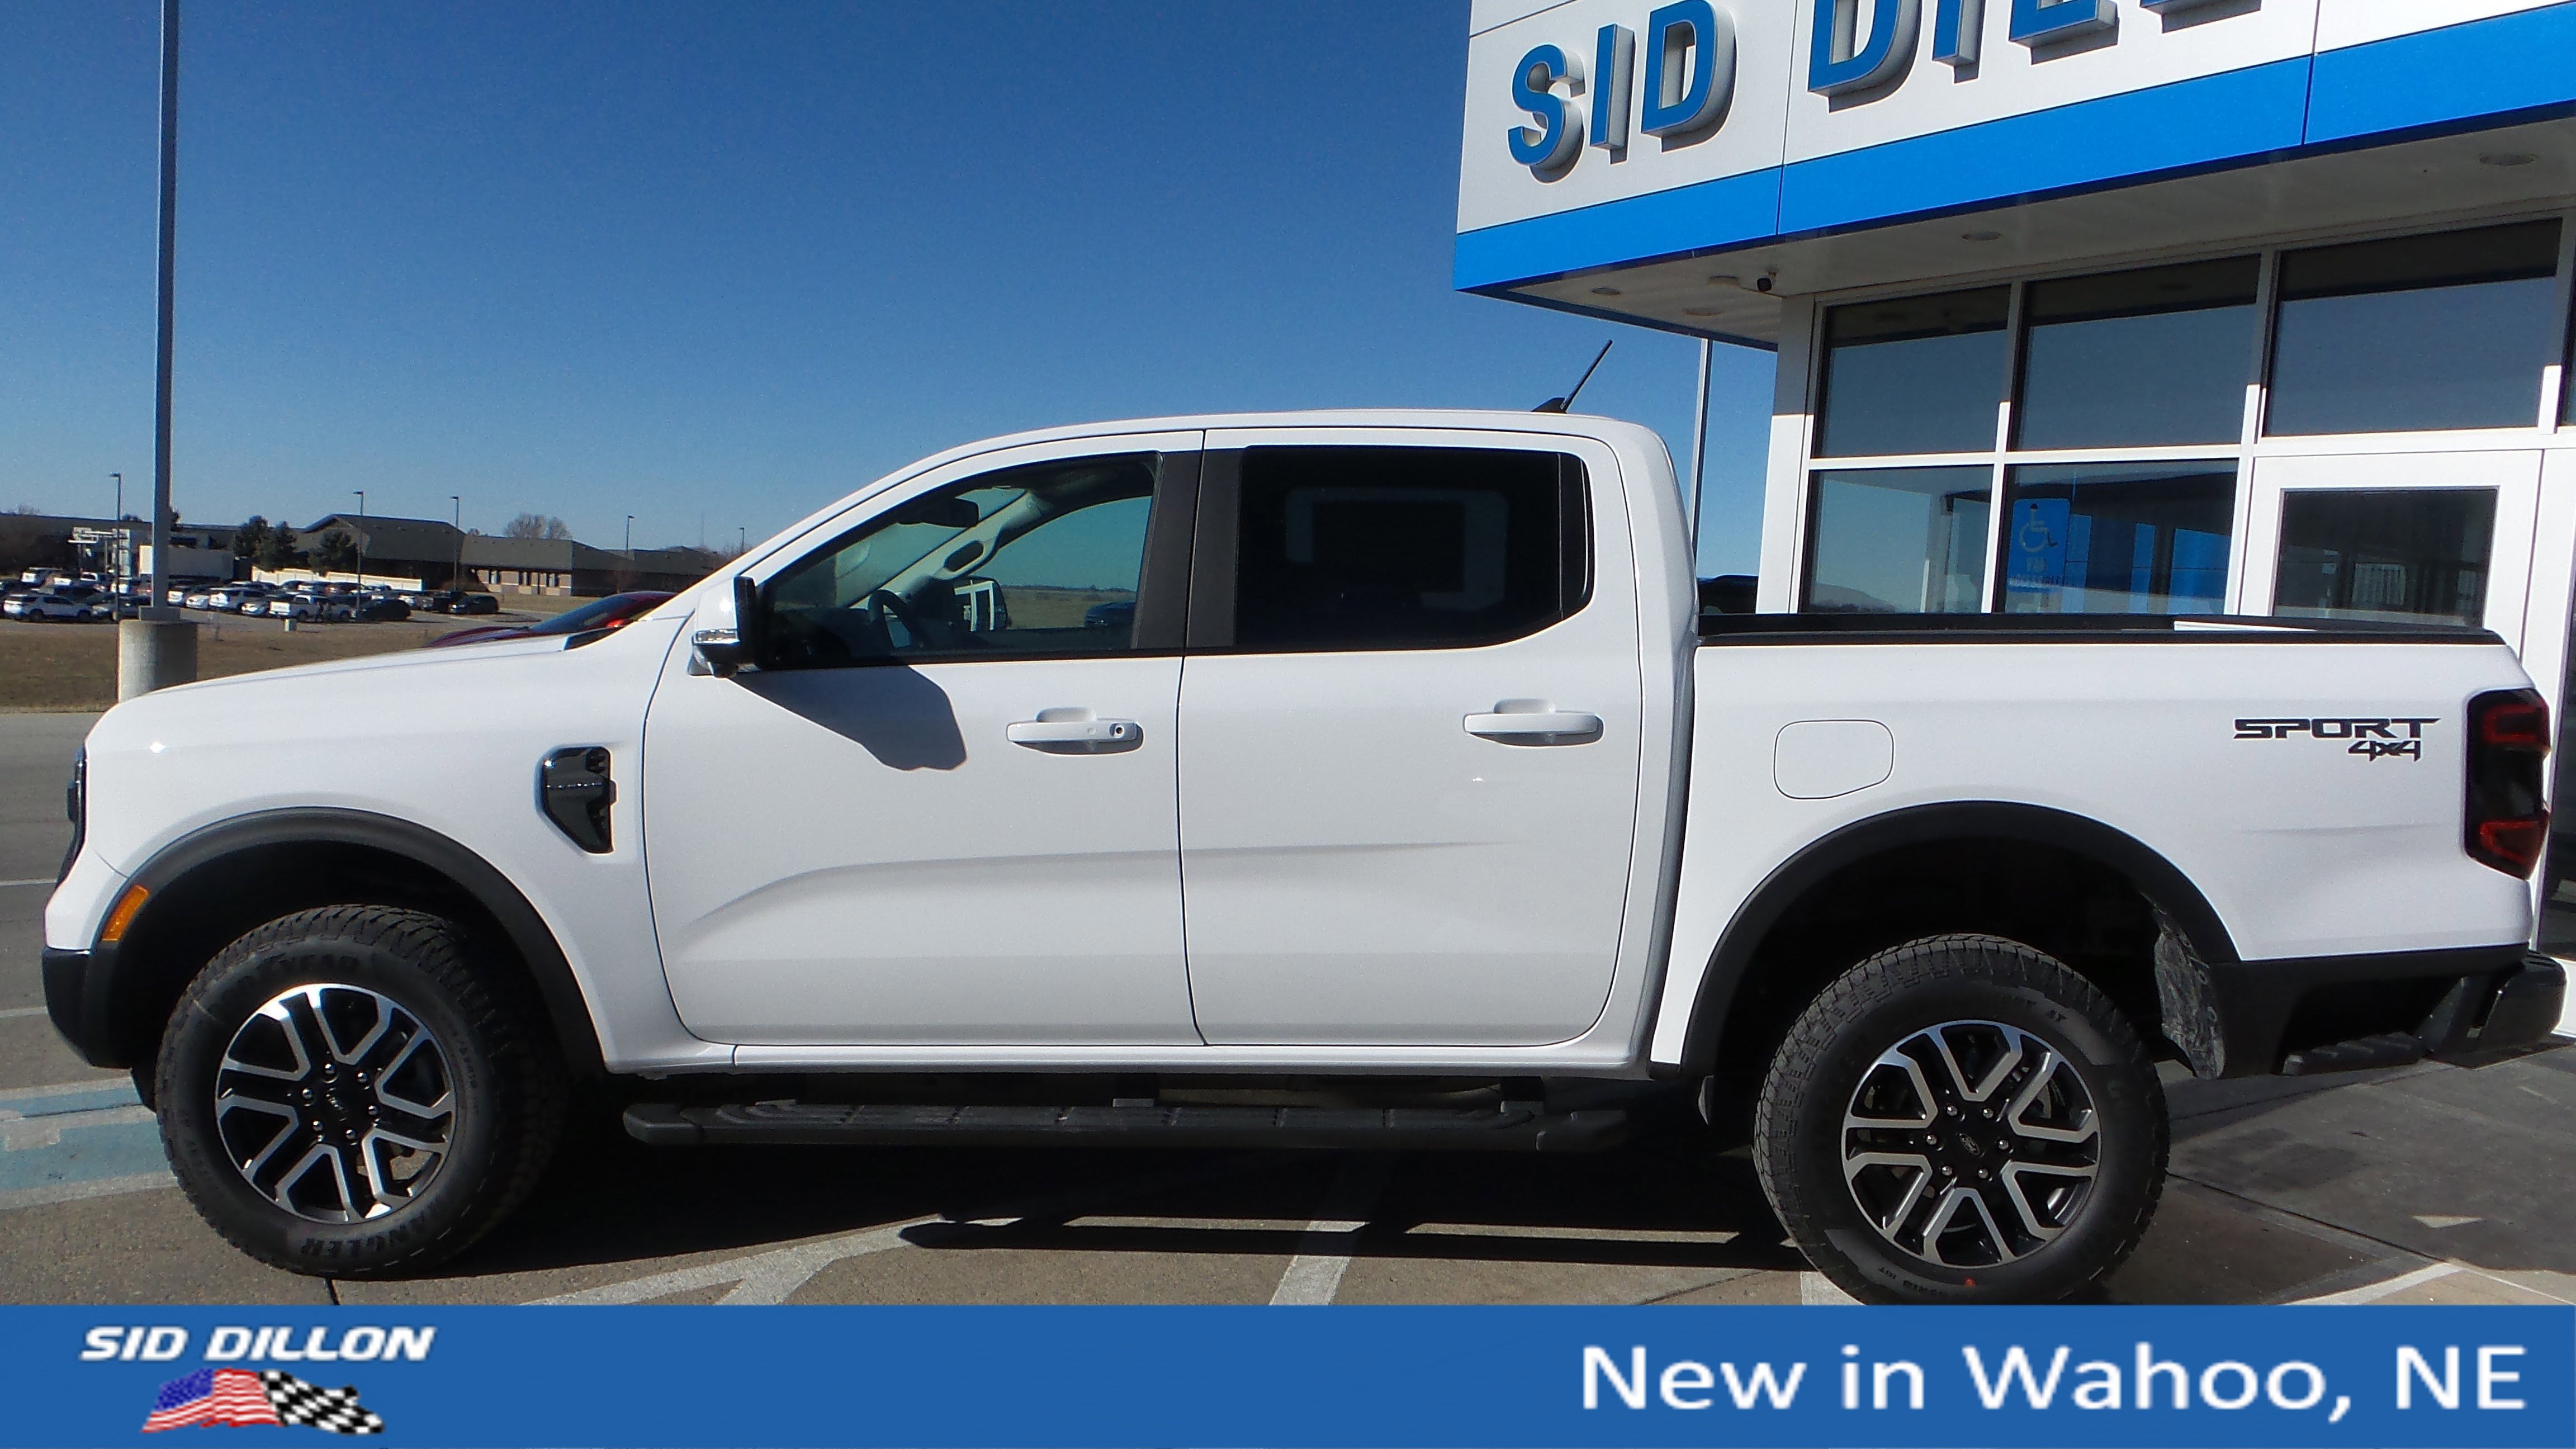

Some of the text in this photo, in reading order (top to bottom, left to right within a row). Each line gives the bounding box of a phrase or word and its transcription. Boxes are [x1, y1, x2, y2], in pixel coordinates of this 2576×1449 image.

[1508, 0, 1733, 168] SID
[2233, 718, 2441, 739] SPORT
[2347, 741, 2421, 762] 4x4
